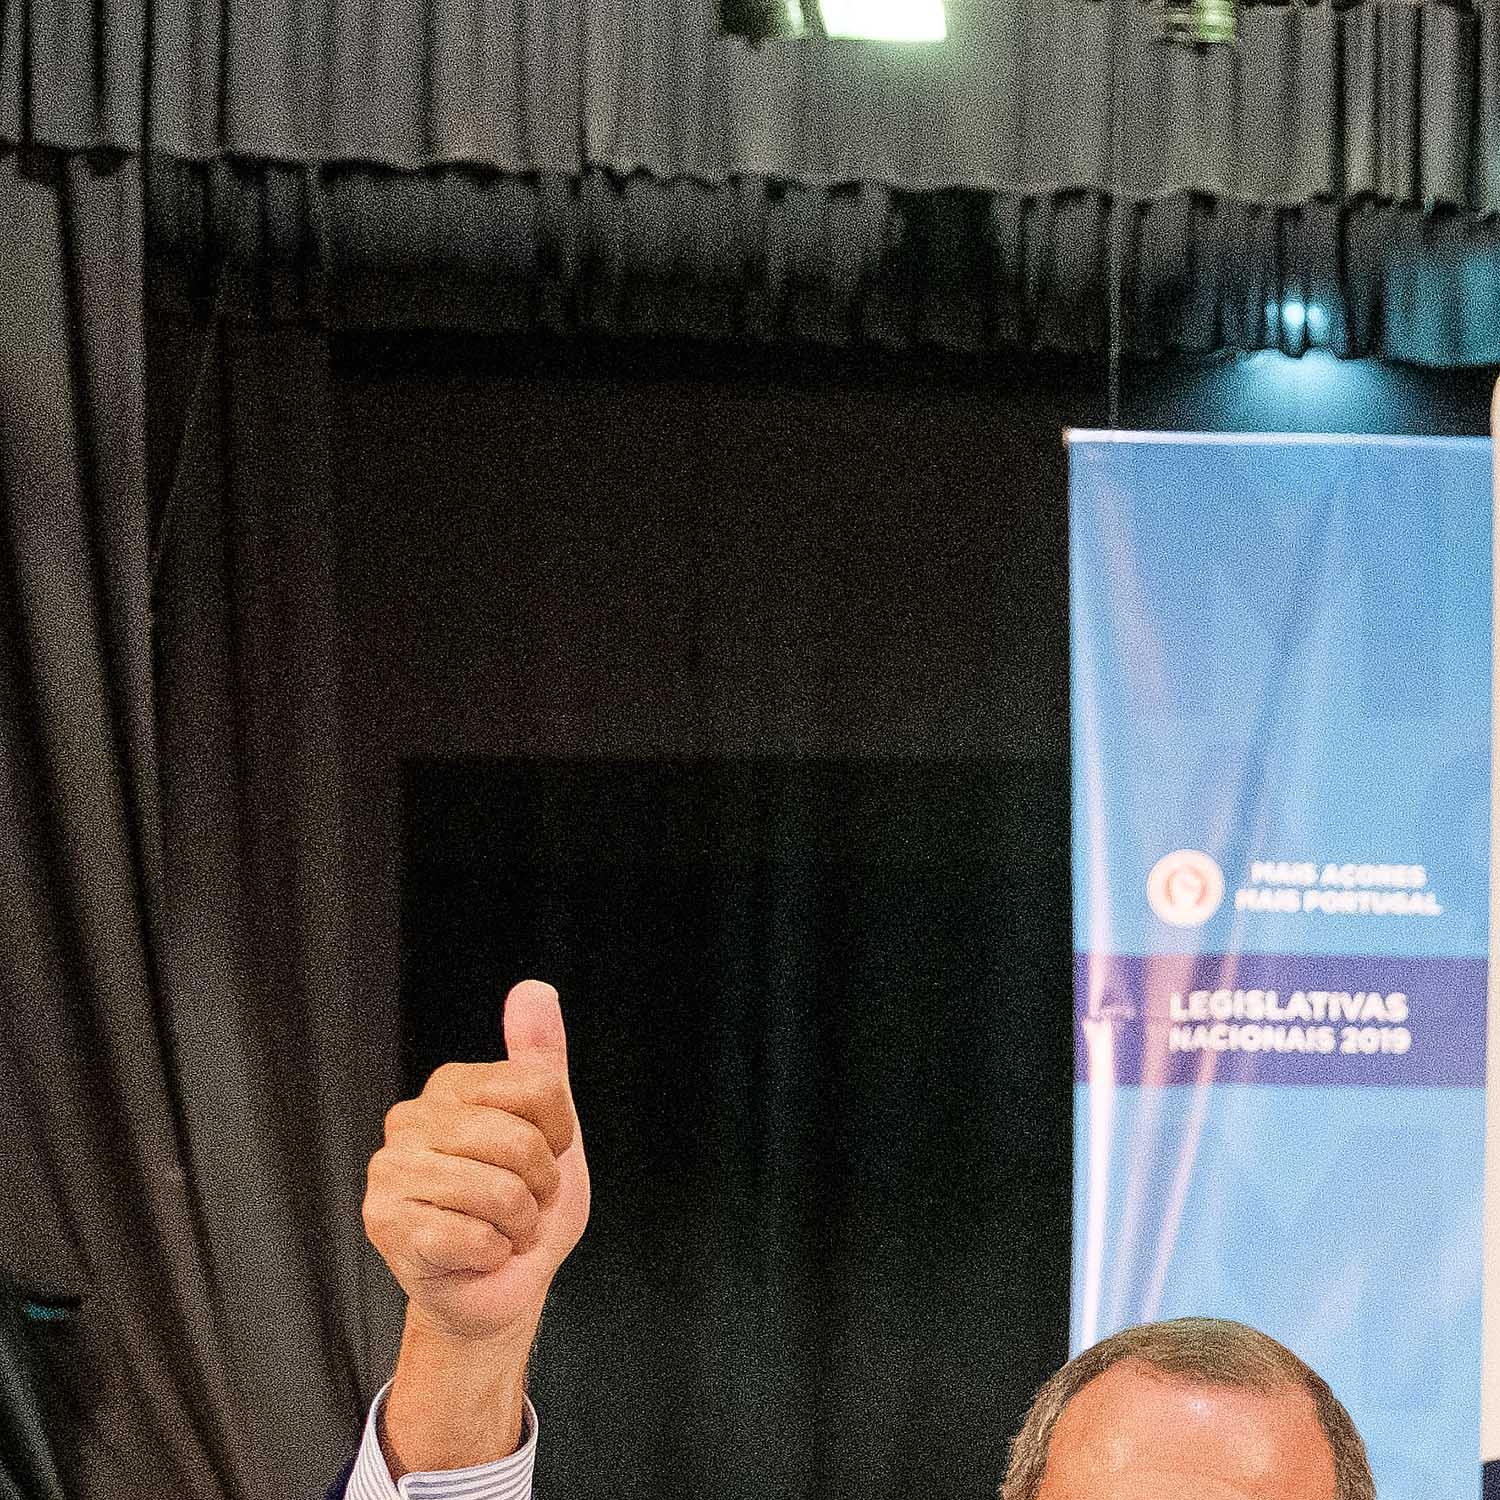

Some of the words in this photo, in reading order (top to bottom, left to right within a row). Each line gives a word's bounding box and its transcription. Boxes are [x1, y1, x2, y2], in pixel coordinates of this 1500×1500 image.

[1169, 989, 1409, 1022] LEGISLATIVAS
[1169, 1024, 1335, 1053] NACIONAIS
[1340, 1026, 1412, 1055] 2019
